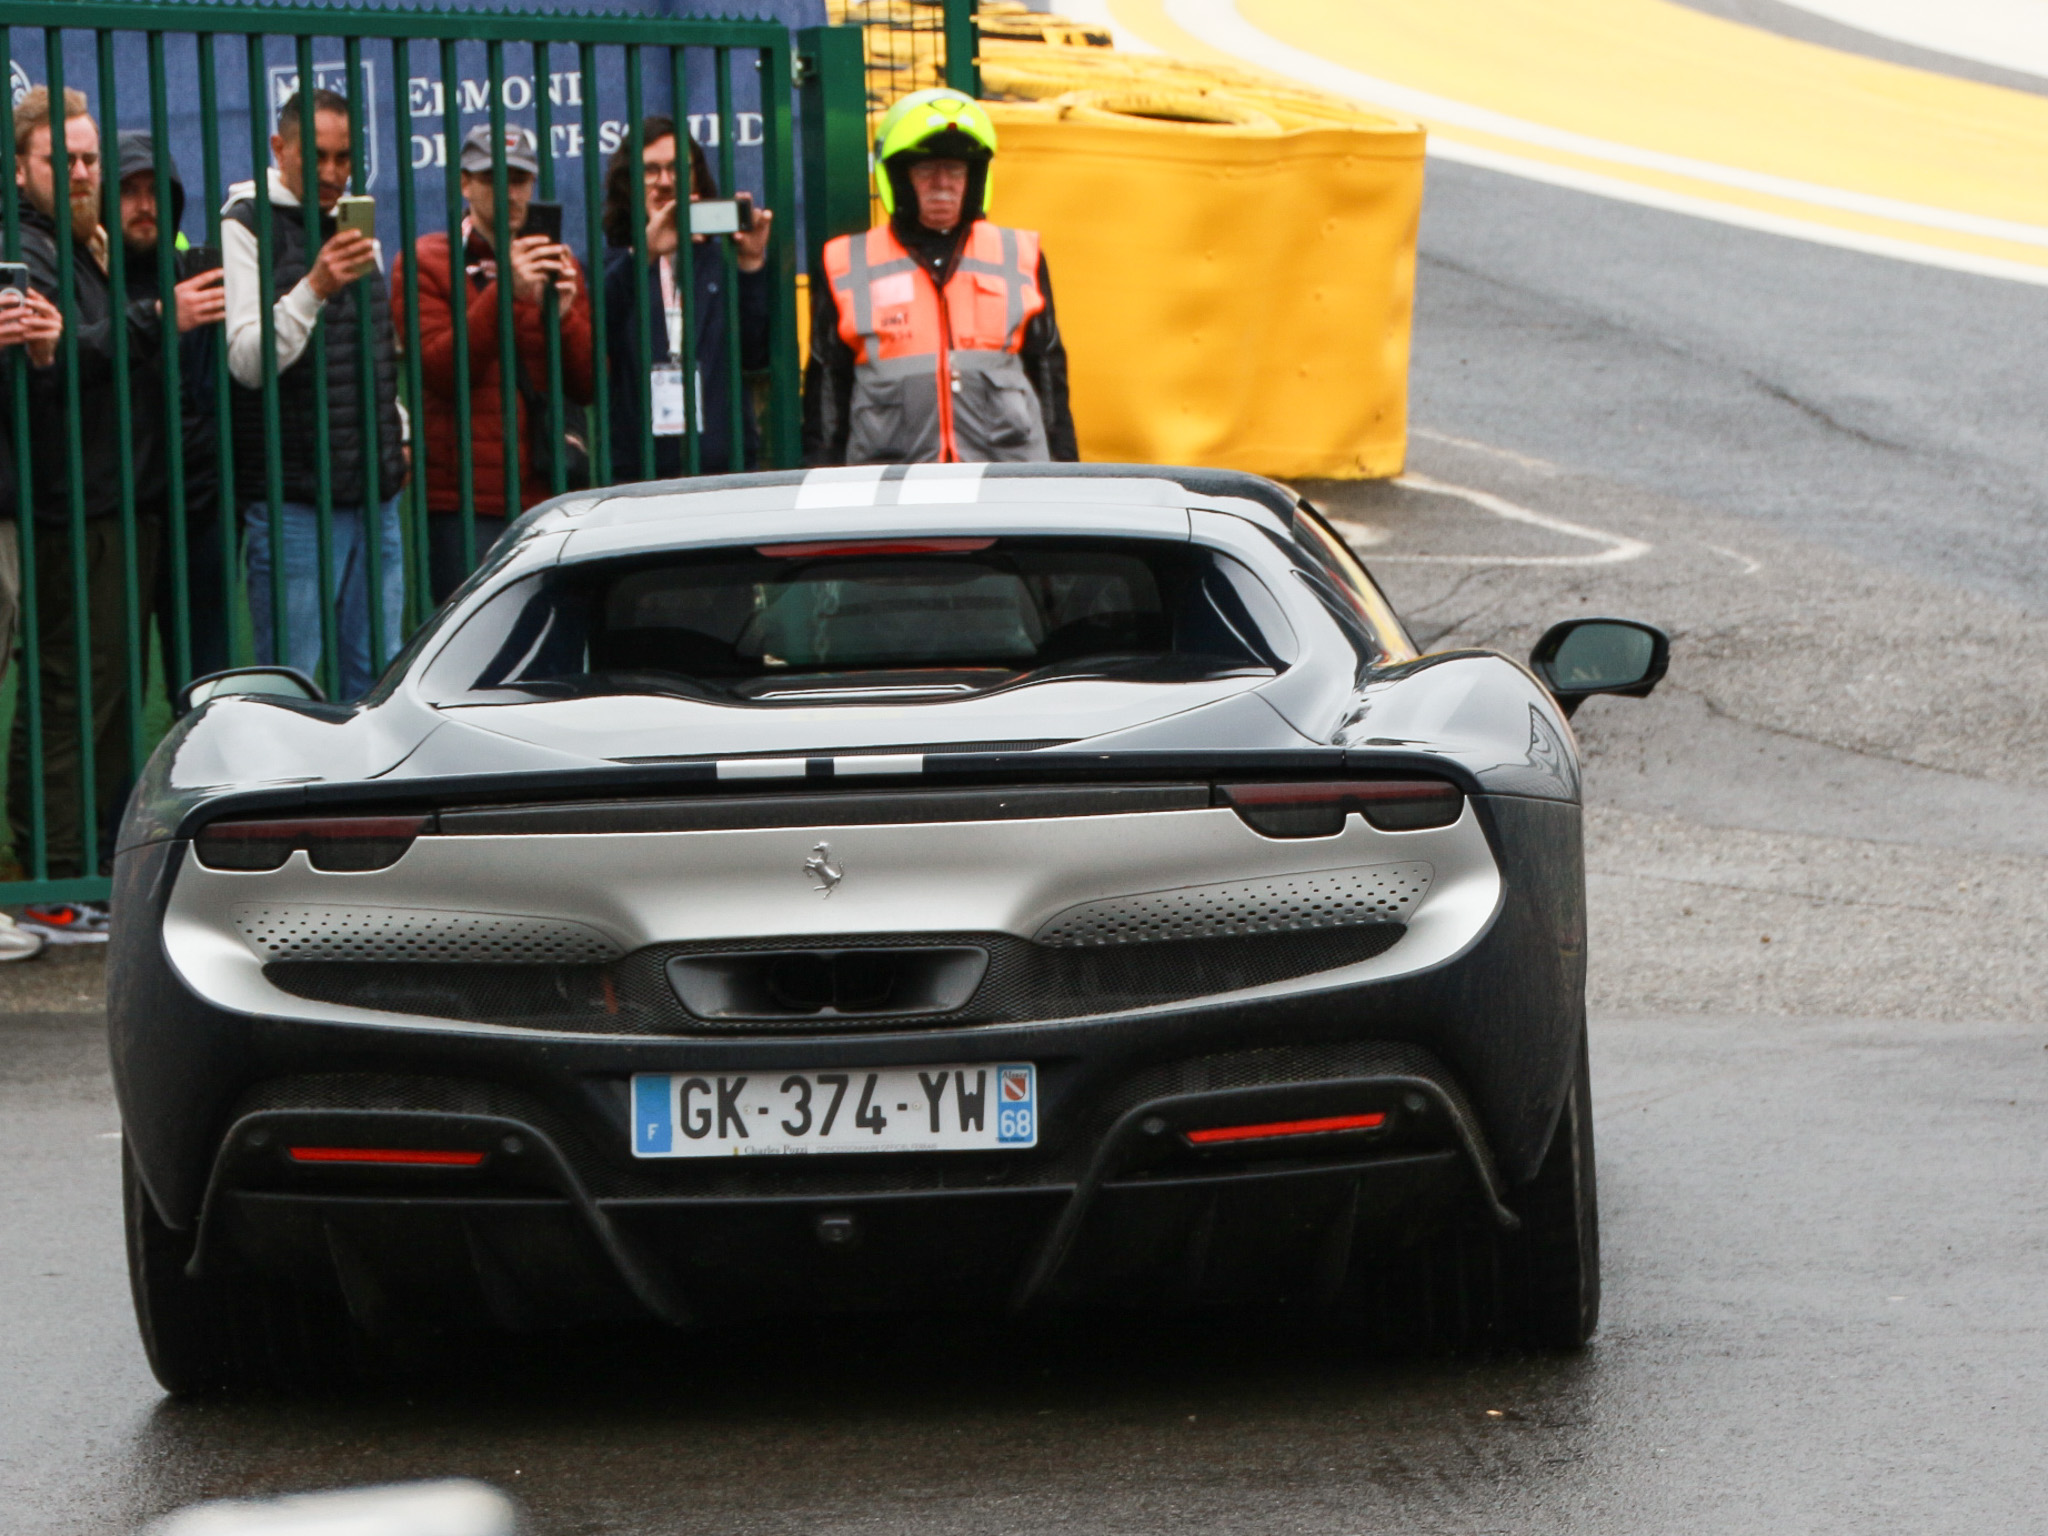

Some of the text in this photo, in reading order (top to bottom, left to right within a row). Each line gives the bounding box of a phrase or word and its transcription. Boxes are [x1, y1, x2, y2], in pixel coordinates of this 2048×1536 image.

[679, 1070, 986, 1139] GK-374-YW
[647, 1123, 659, 1140] F
[1001, 1109, 1031, 1137] 68
